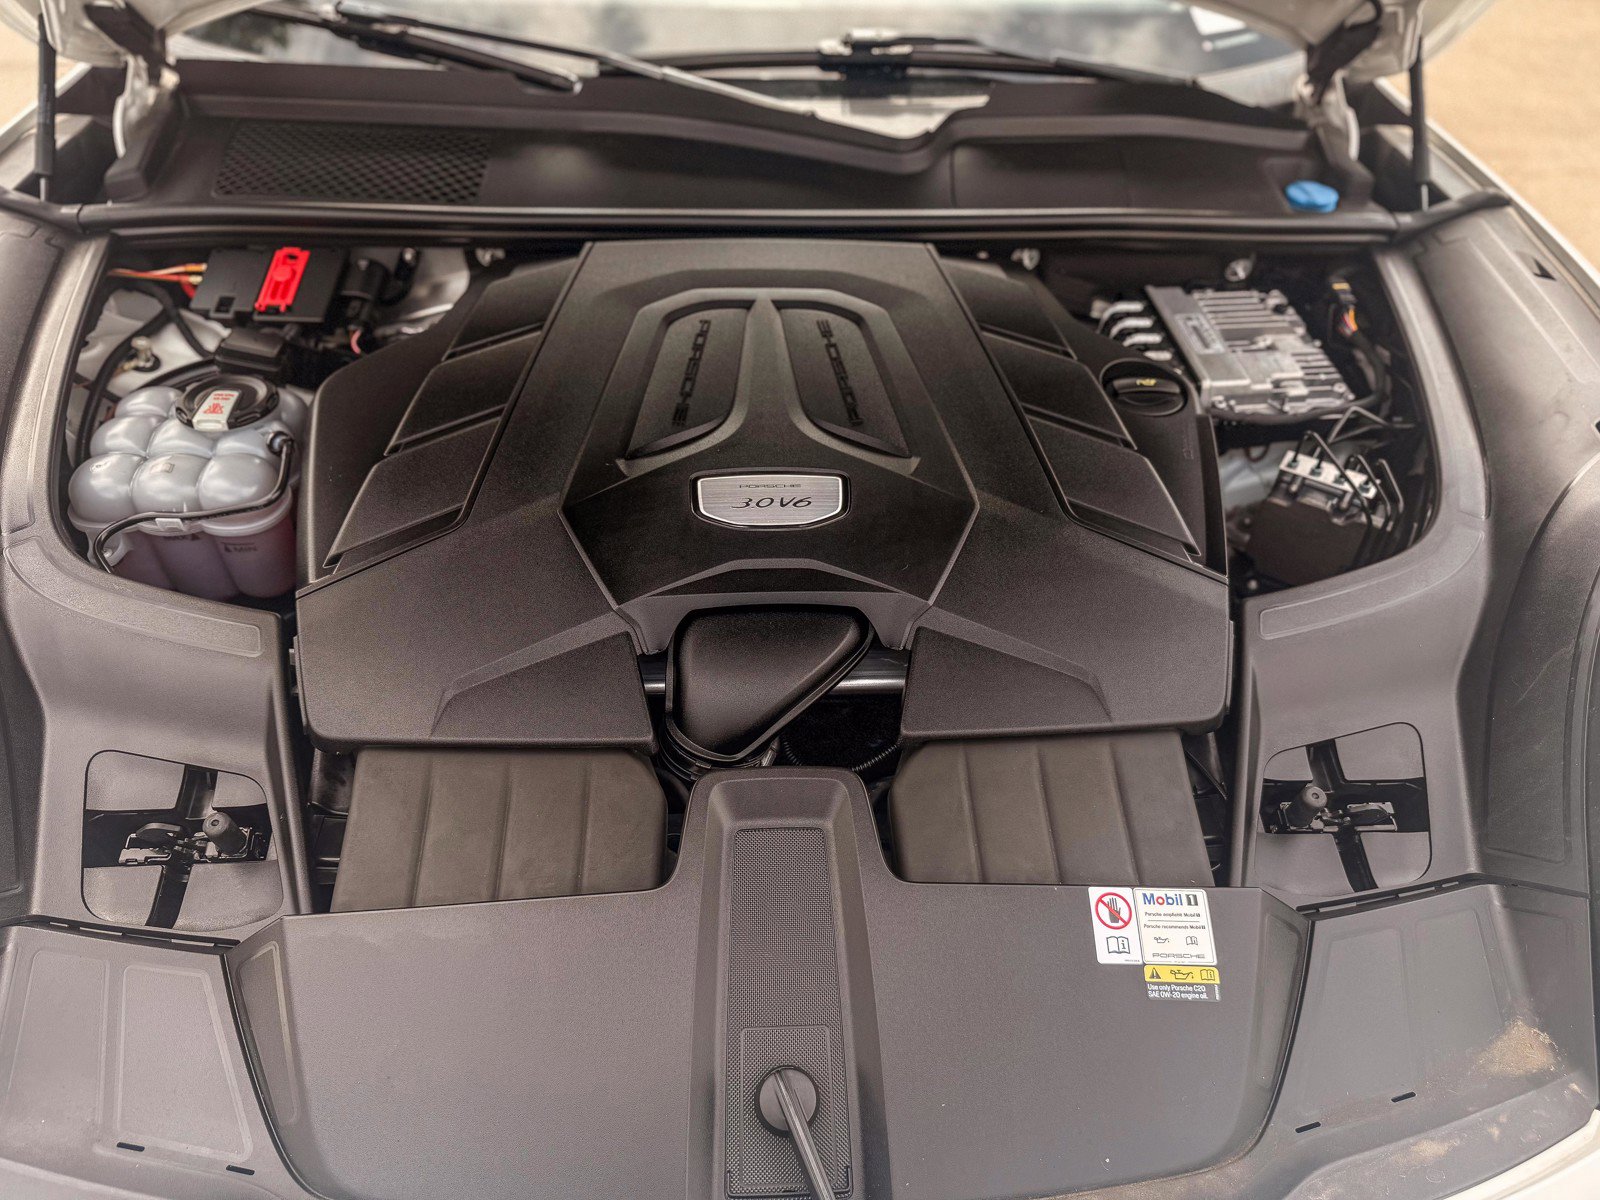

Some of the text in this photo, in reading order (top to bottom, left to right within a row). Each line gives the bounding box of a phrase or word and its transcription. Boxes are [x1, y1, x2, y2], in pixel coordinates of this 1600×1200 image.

[672, 319, 711, 426] PORSCHE
[816, 319, 863, 426] PORSCHE
[1142, 892, 1183, 906] Mobil
[1147, 983, 1158, 991] Use
[1158, 984, 1171, 992] only
[1170, 984, 1193, 992] Porsche
[1193, 984, 1206, 992] C20
[1148, 990, 1160, 998] SAE
